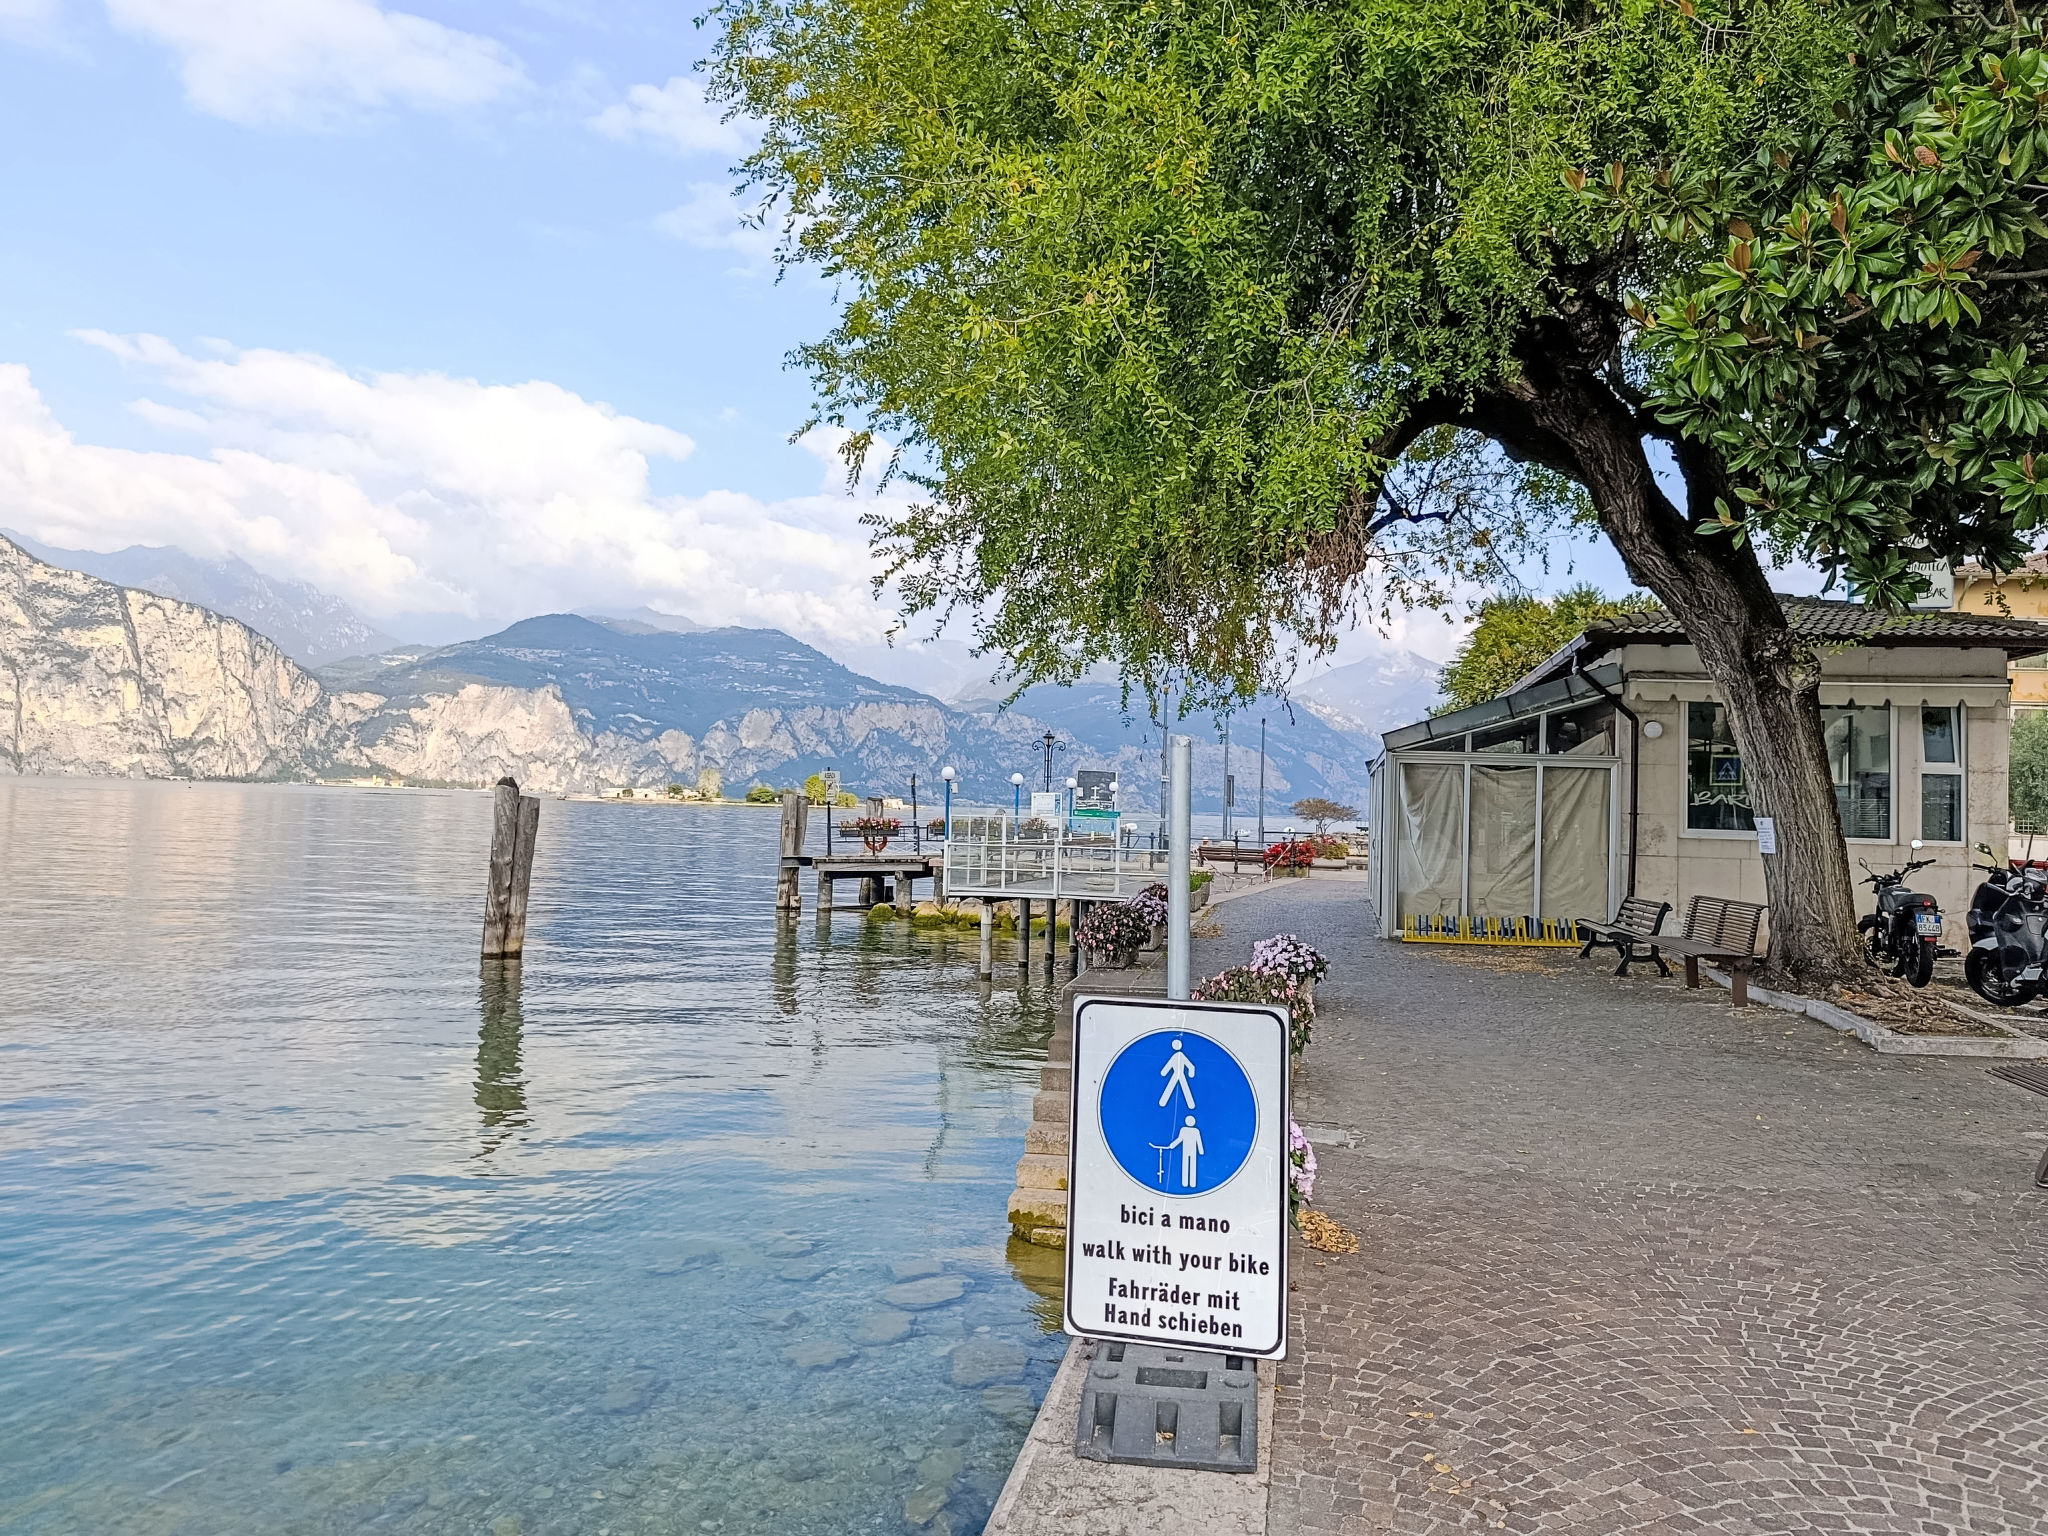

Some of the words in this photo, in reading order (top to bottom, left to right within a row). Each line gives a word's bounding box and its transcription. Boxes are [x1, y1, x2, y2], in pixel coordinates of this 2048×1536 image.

[1919, 587, 1949, 600] BAR
[1121, 1204, 1154, 1226] bici
[1161, 1213, 1171, 1228] a
[1180, 1215, 1230, 1234] mano
[1083, 1239, 1125, 1261] walk
[1133, 1245, 1171, 1266] with
[1179, 1253, 1222, 1272] your
[1230, 1252, 1270, 1276] bike
[1108, 1277, 1201, 1306] Fahrräder
[1208, 1291, 1240, 1311] mit
[1104, 1303, 1151, 1327] Hand
[1158, 1311, 1242, 1338] schieben
